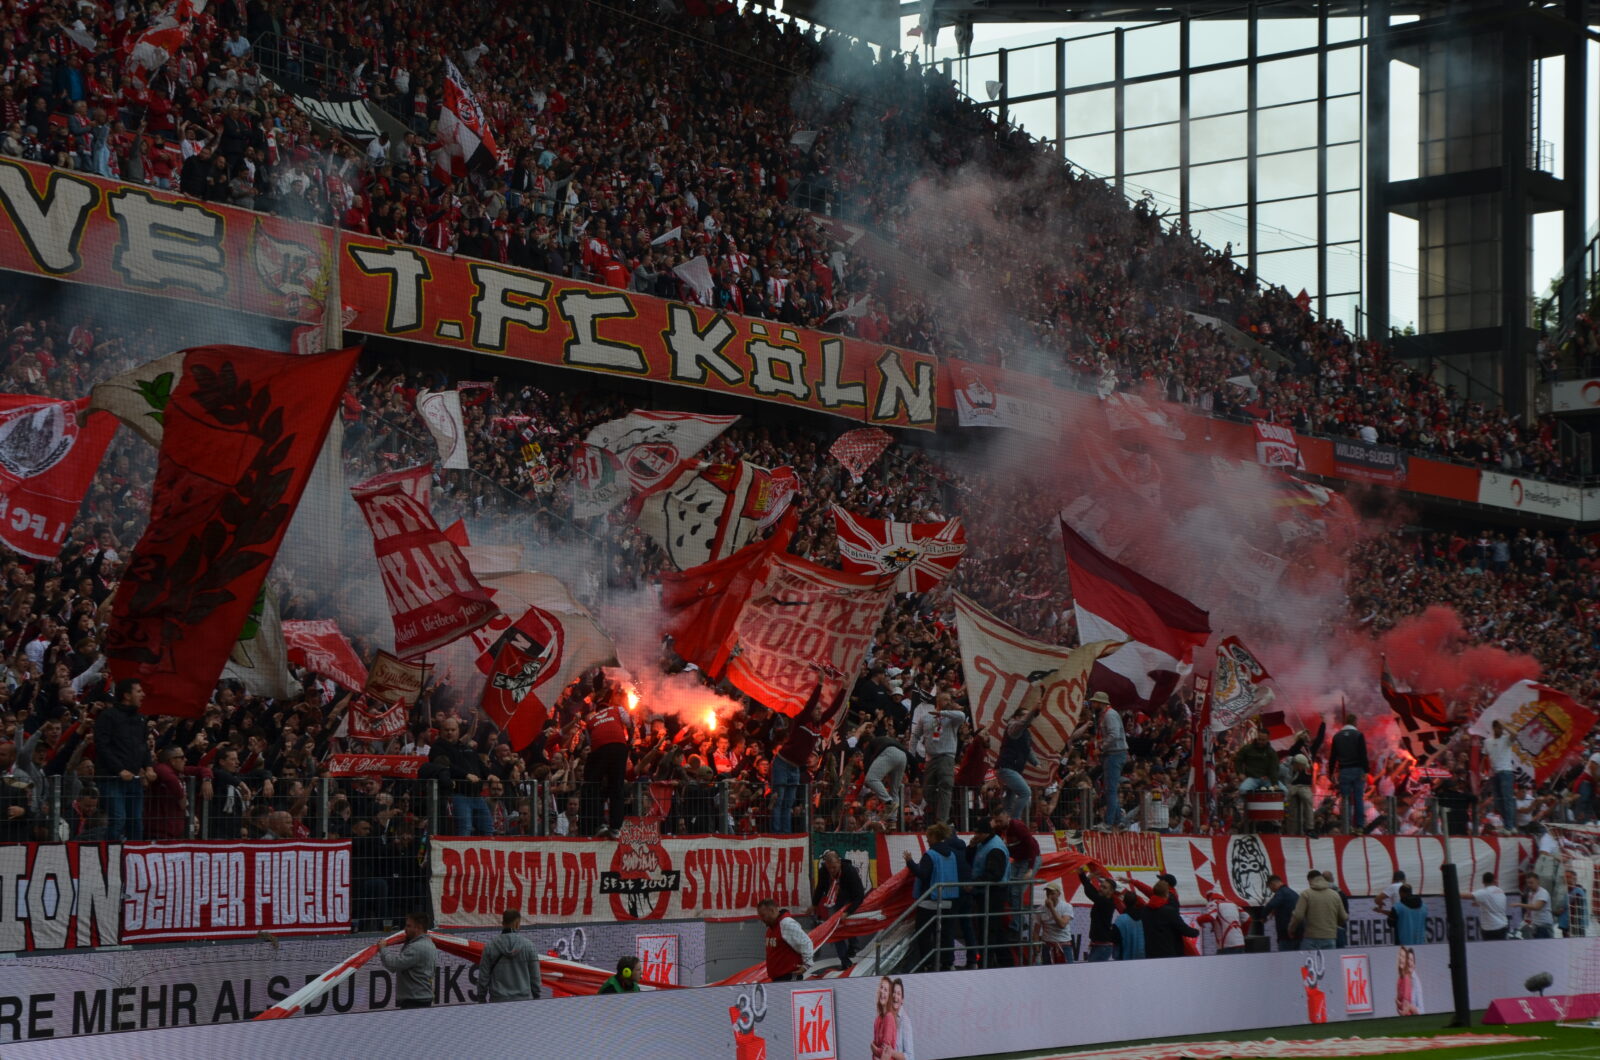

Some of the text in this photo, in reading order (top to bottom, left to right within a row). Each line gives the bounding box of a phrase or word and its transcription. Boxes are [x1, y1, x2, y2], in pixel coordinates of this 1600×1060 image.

[660, 303, 935, 424] KÖLN
[124, 849, 351, 932] SEMPER FIDELIS
[441, 847, 804, 916] DOMSTADT SYNDIKAT
[72, 983, 198, 1035] MEHR
[1346, 967, 1368, 1005] kik
[799, 1005, 830, 1054] kik
